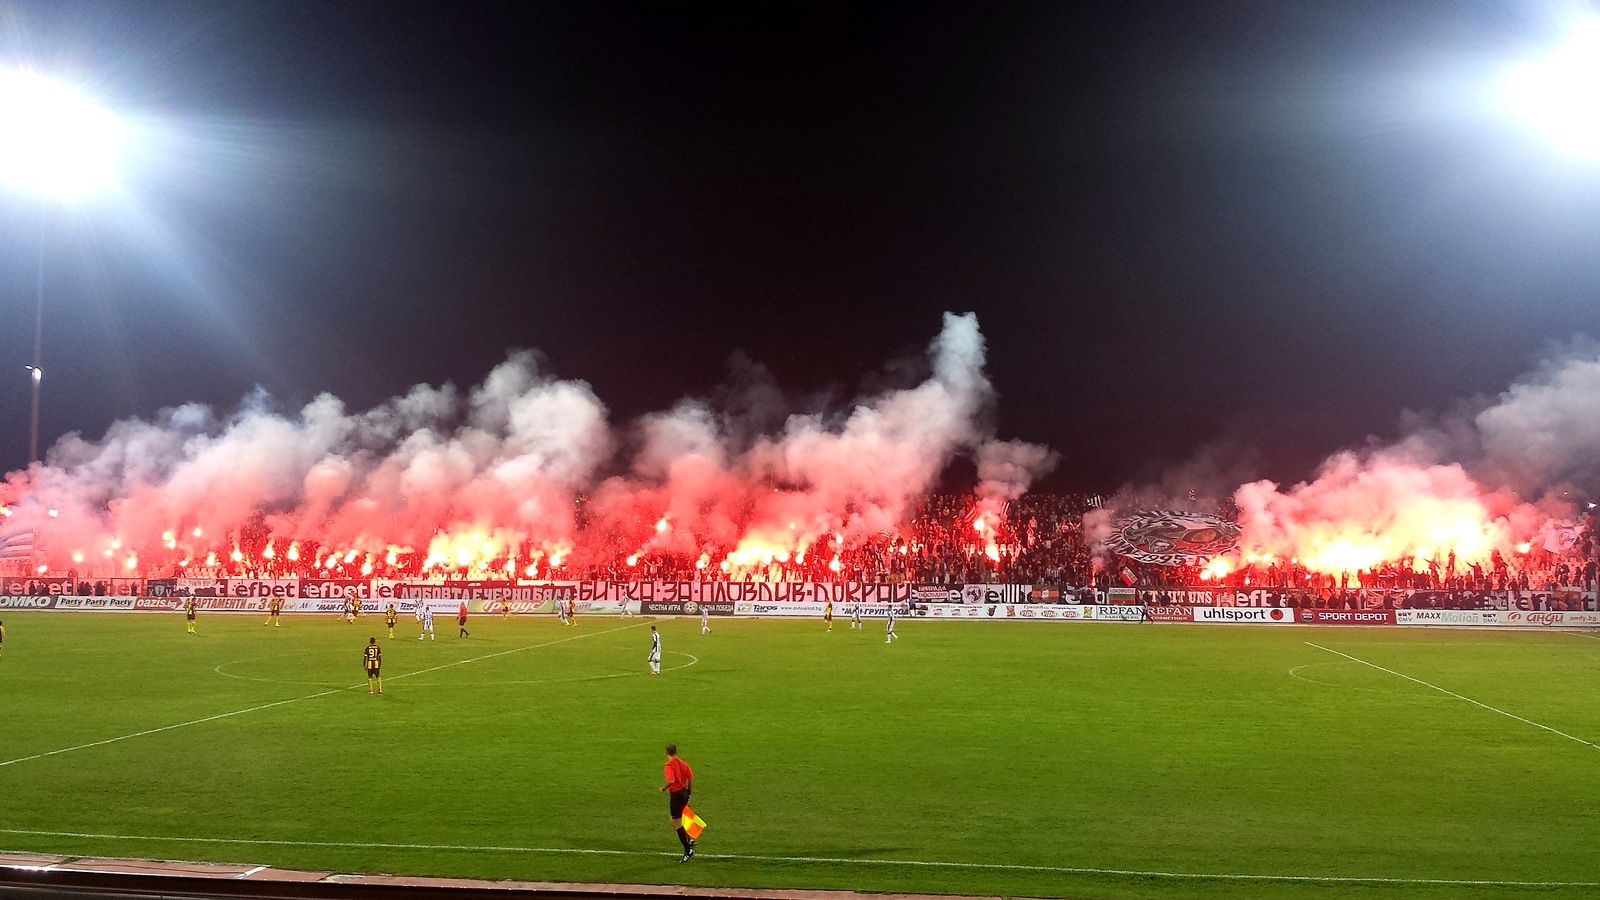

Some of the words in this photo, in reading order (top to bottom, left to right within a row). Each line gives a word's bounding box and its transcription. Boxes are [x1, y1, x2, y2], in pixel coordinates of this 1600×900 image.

[8, 580, 72, 595] efet
[235, 582, 296, 597] efbet
[305, 582, 368, 598] efbet
[400, 587, 470, 599] ЛЮБОВТА
[662, 581, 692, 601] ЗА
[700, 582, 806, 602] ПЛОВДИВ
[60, 598, 82, 606] Party
[85, 598, 108, 606] Party
[137, 598, 177, 608] oazis.bg
[1188, 591, 1212, 604] UNS
[1099, 607, 1144, 615] REFAN
[1148, 607, 1192, 615] REFAN
[1203, 608, 1266, 621] uhlsport
[1441, 612, 1479, 622] Motion
[368, 648, 378, 658] 91
